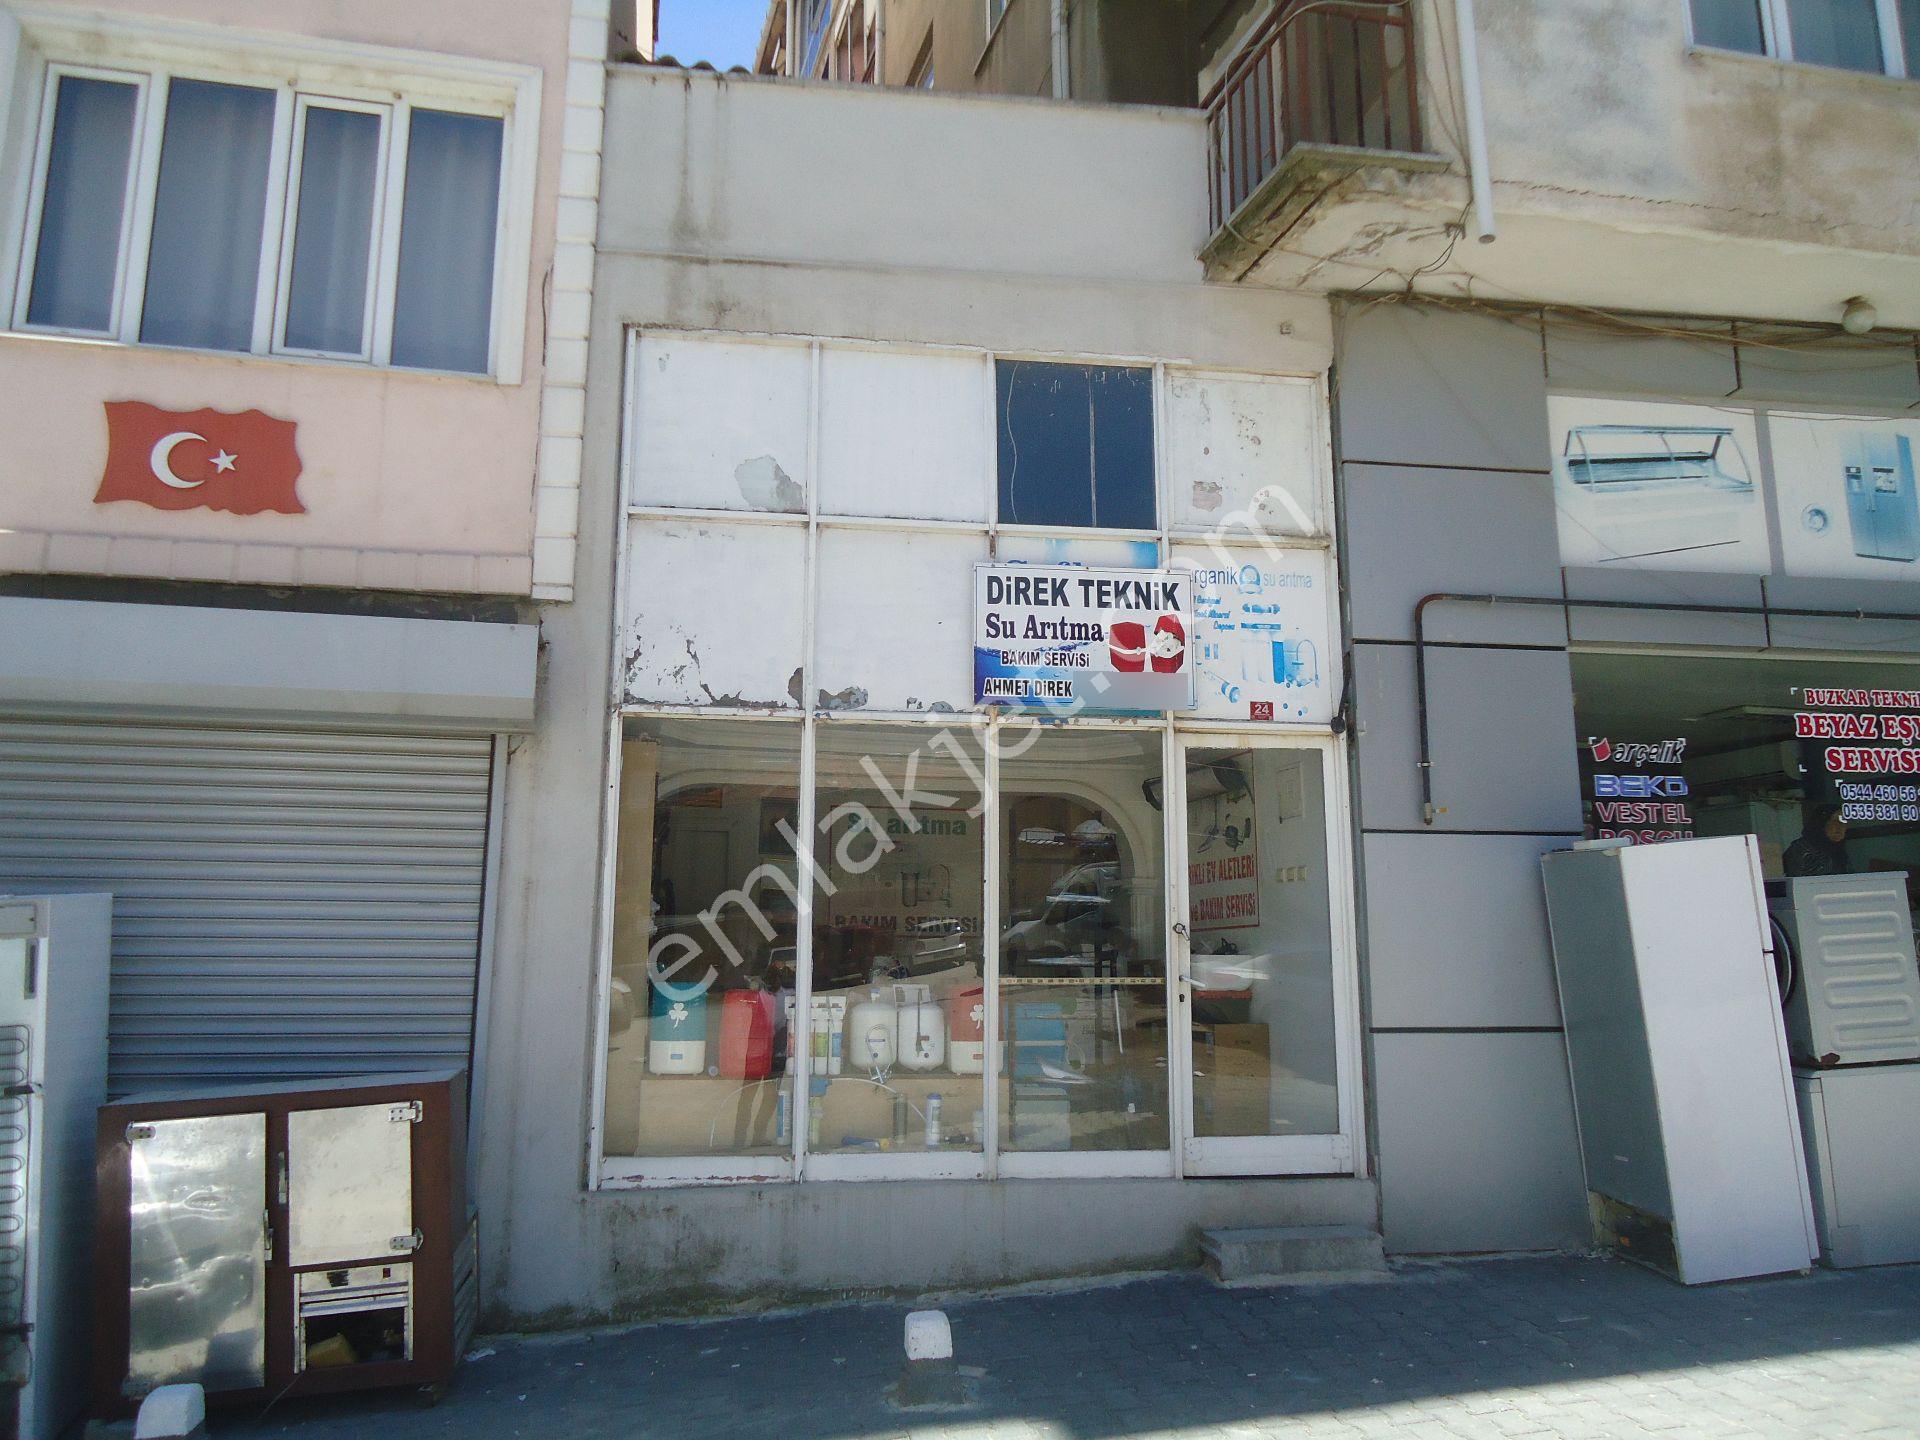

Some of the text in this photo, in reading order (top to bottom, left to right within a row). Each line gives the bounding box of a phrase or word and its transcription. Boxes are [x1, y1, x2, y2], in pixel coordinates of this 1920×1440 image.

[1191, 566, 1239, 588] rganik
[985, 612, 1105, 642] Su Arıtma
[1001, 650, 1040, 666] BAKIM
[984, 678, 1029, 696] AHMET
[1804, 688, 1920, 708] BUZKAR TEKNi
[1254, 704, 1270, 714] 24
[1794, 713, 1878, 738] BEYAZ
[1613, 740, 1685, 767] arçelik
[1594, 774, 1688, 797] BEKO
[1840, 784, 1916, 802] 0544 460 56
[1596, 802, 1692, 824] VESTEL
[1842, 803, 1918, 821] 0535 381 90
[887, 815, 967, 836] artma
